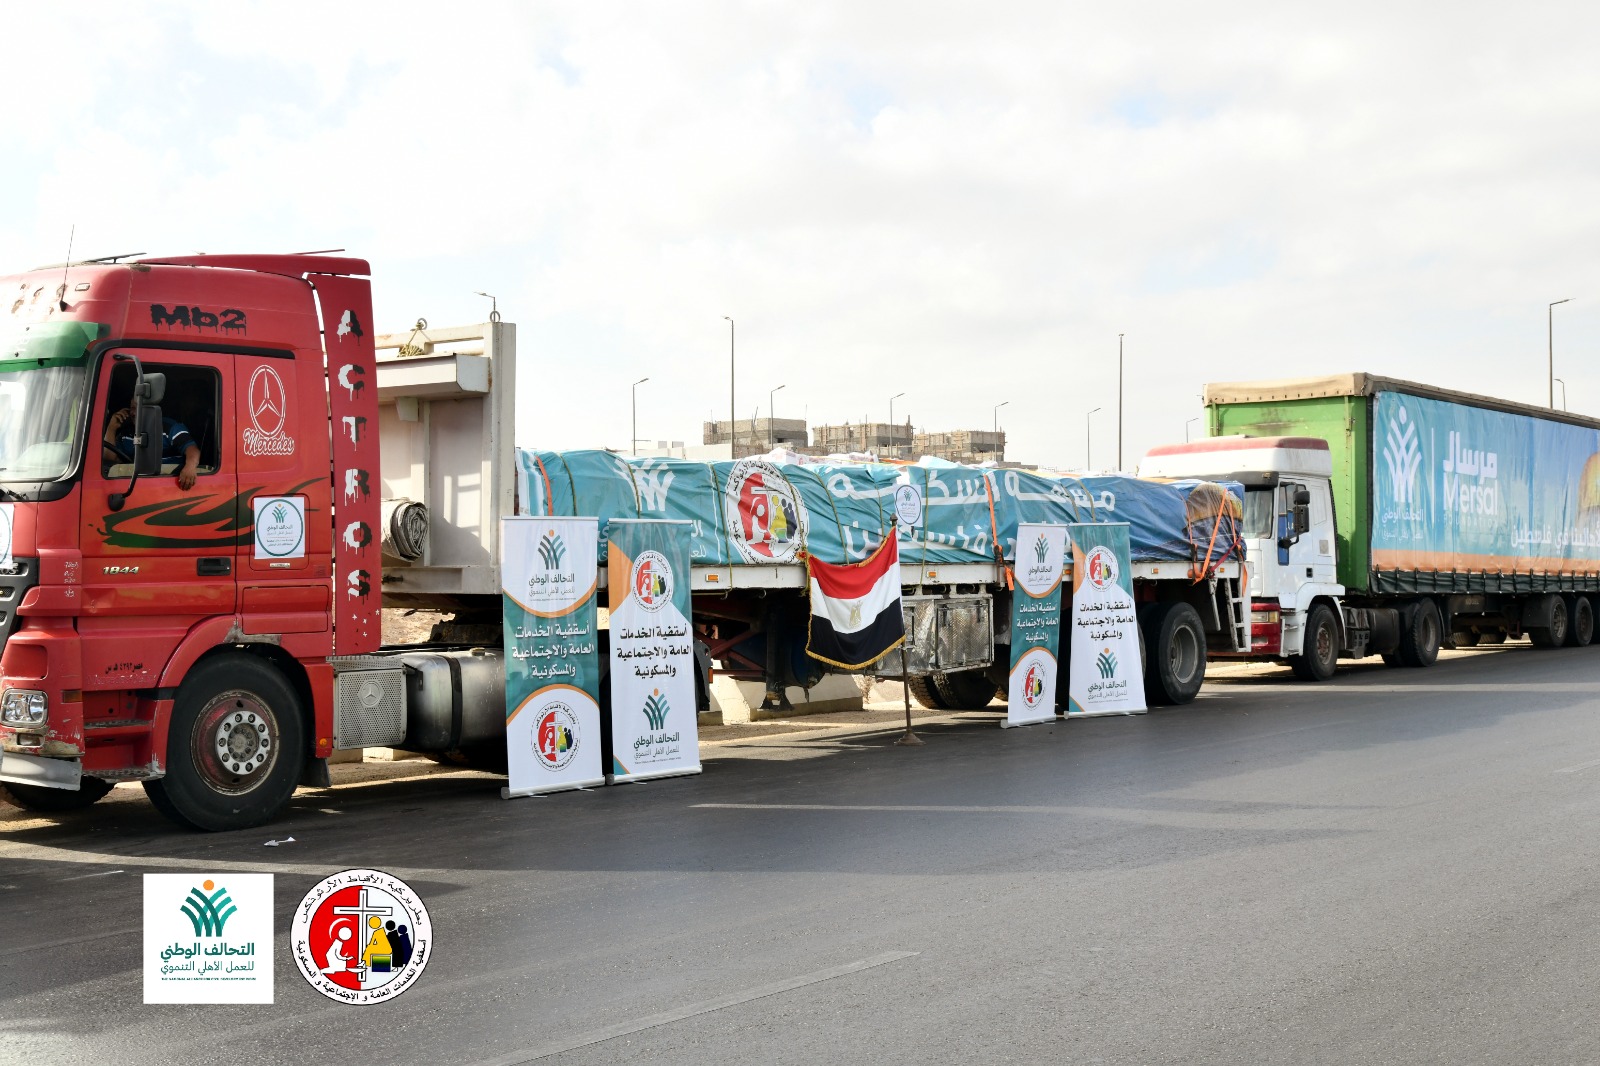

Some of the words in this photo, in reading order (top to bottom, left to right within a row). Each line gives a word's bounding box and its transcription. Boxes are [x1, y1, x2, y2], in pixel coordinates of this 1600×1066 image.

[150, 304, 247, 336] Mb2
[243, 428, 295, 456] Mercedes
[1443, 431, 1498, 484] مرسال
[1443, 473, 1498, 515] Mersal
[1382, 506, 1401, 527] الوطني
[1511, 524, 1552, 549] فلسطين
[1555, 527, 1568, 554] في
[691, 545, 707, 558] للع
[103, 566, 139, 574] 1844
[529, 573, 549, 588] الوطني
[550, 573, 575, 583] التحالف
[1080, 603, 1105, 612] الخدمات
[1107, 599, 1131, 613] أسقفية
[1077, 617, 1115, 627] والاجتماعية
[1116, 615, 1135, 624] العامة
[515, 626, 554, 638] الخدمات
[555, 621, 590, 640] أسقفية
[620, 628, 655, 639] الخدمات
[656, 623, 688, 640] أسقفية
[1090, 631, 1122, 641] والمسكونية
[512, 644, 568, 659] والاجتماعية
[568, 642, 595, 654] العامة
[617, 646, 668, 660] والاجتماعية
[669, 644, 692, 655] العامة
[531, 665, 576, 679] والمسكونية
[634, 665, 676, 679] والمسكونية
[1087, 681, 1105, 694] الوطني
[1106, 680, 1127, 689] التحالف
[633, 734, 654, 751] الوطني
[655, 732, 680, 744] التحالف
